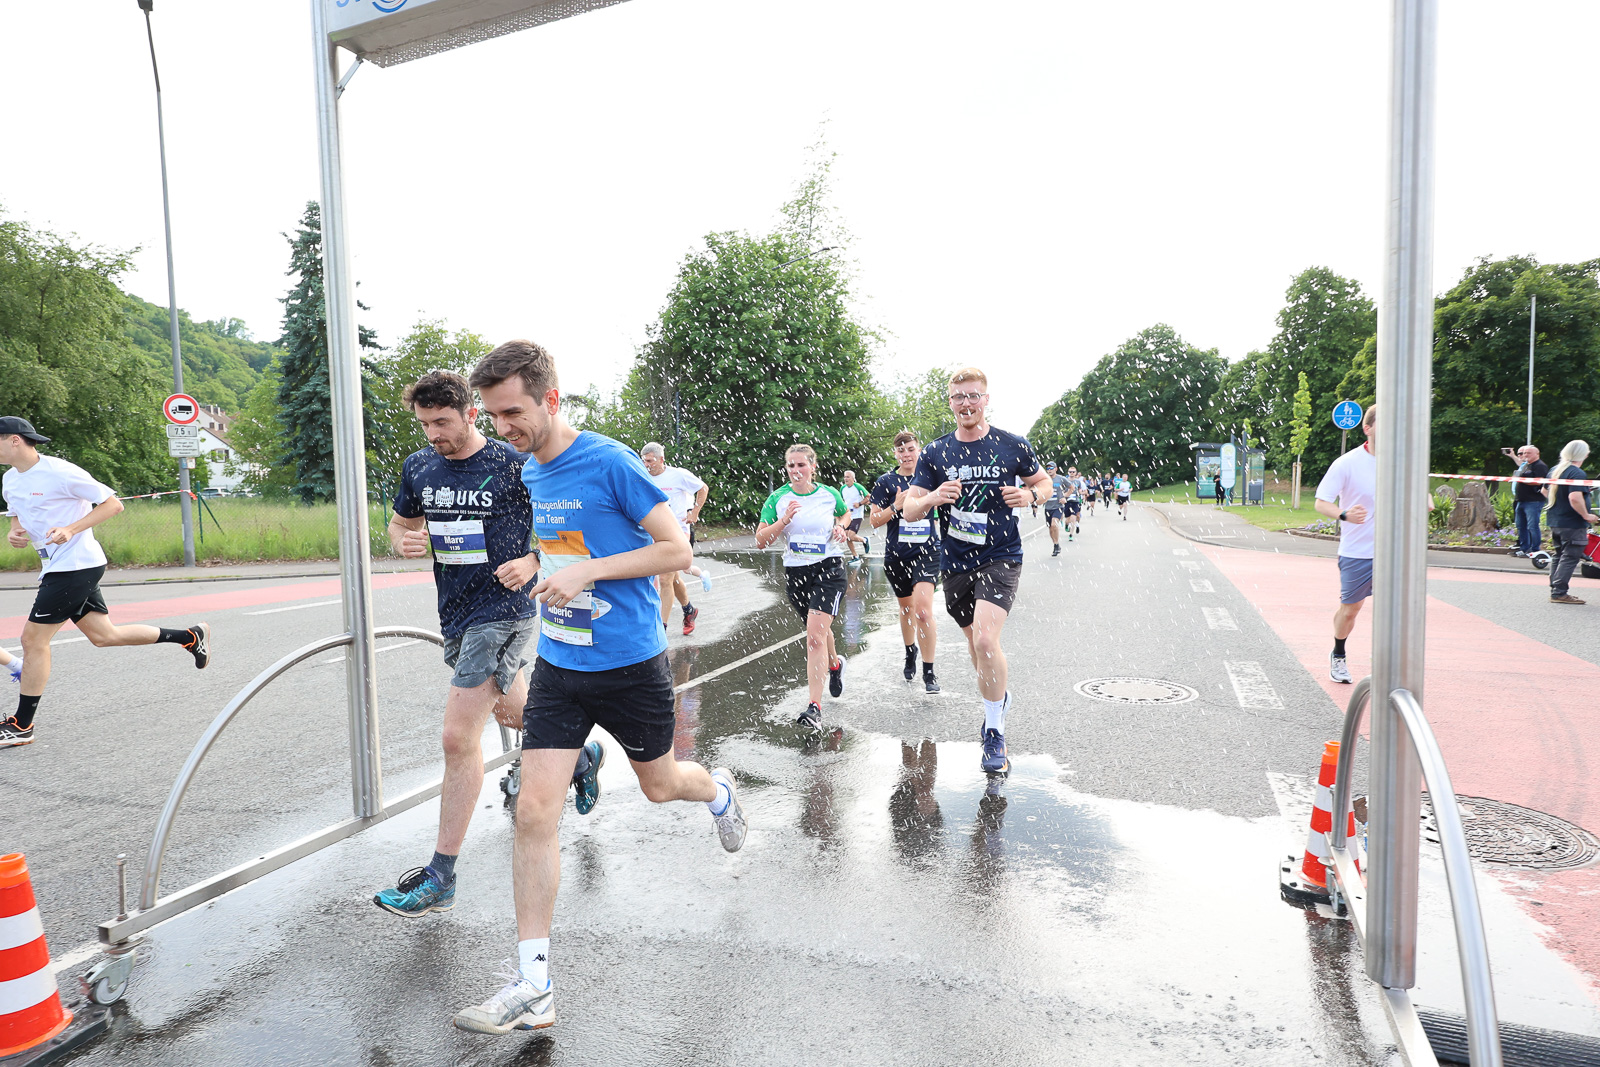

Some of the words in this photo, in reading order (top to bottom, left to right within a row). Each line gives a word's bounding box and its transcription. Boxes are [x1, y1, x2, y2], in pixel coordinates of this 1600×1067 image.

[973, 465, 1000, 478] UKS
[456, 490, 493, 507] UKS
[537, 498, 583, 512] Augenklinik
[535, 513, 546, 524] ein
[545, 513, 566, 524] Team
[444, 536, 464, 544] Marc
